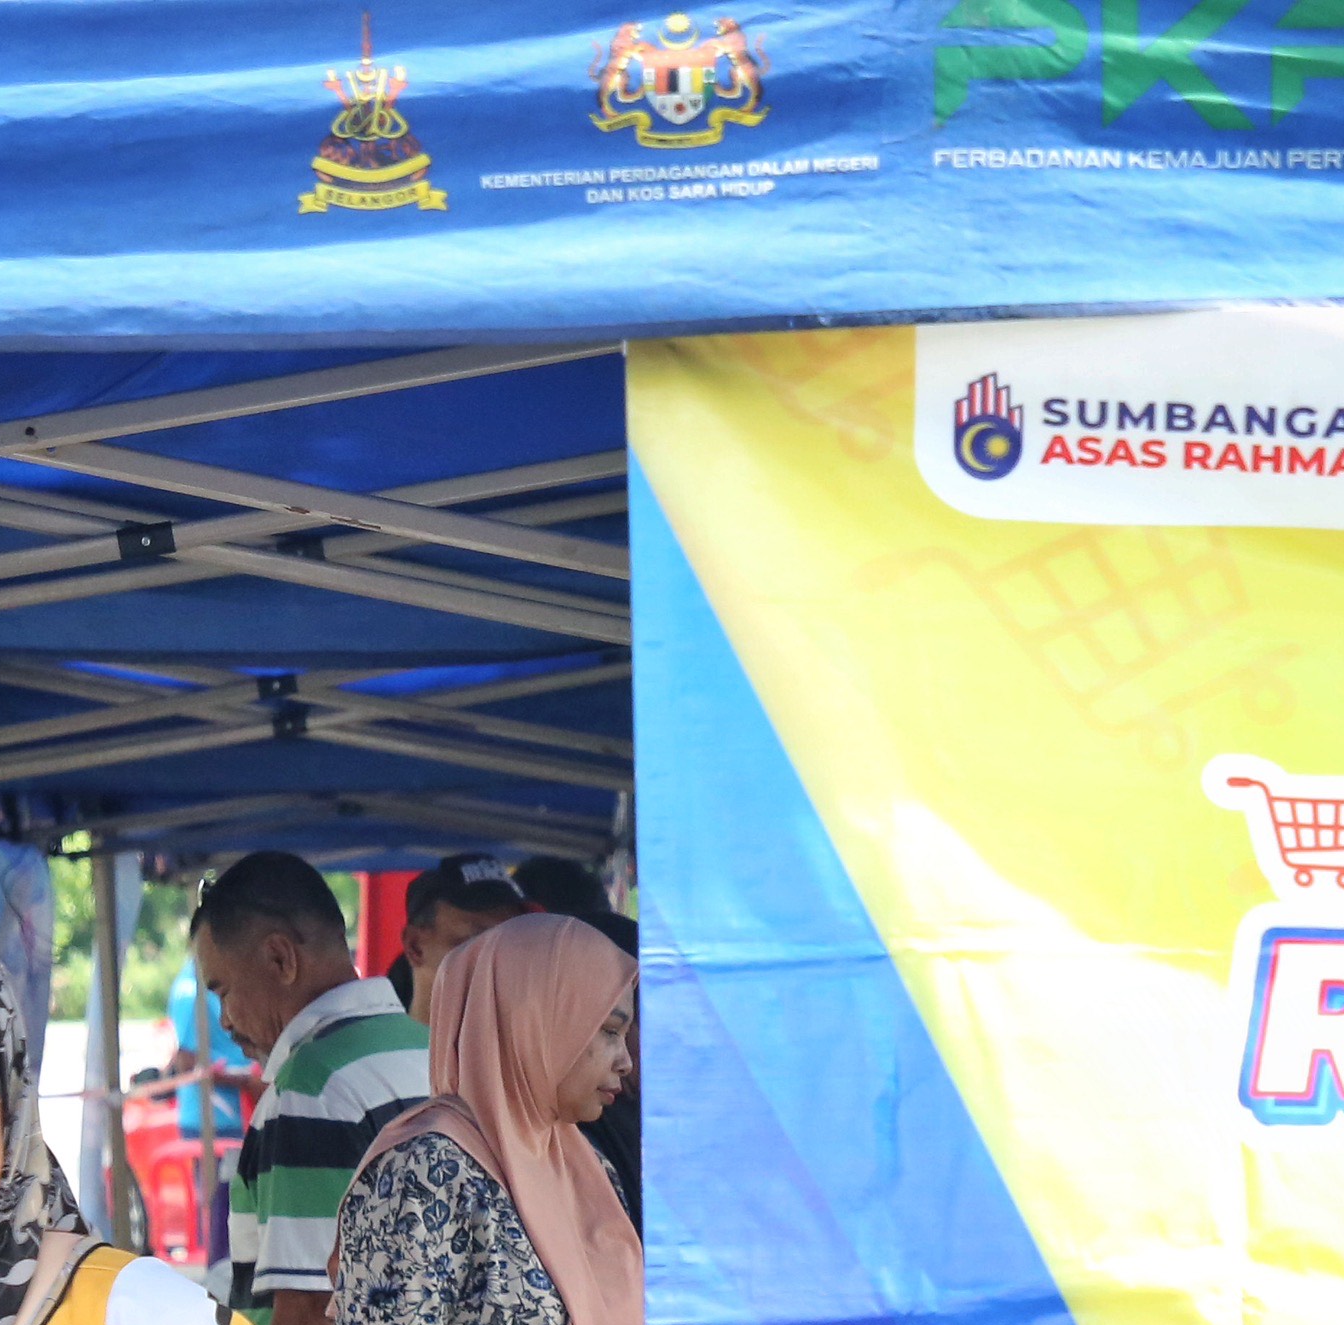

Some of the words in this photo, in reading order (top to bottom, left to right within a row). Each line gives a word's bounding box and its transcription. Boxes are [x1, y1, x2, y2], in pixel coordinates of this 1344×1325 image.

[480, 170, 605, 189] KEMENTERIAN
[610, 164, 743, 183] PERDAGANGAN
[747, 160, 810, 178] DALAM
[813, 156, 878, 173] NEGERI
[933, 147, 1121, 170] PERBADANAN
[1128, 149, 1281, 170] KEMAJUAN
[587, 188, 624, 204] DAN
[628, 185, 664, 202] KOS
[669, 183, 716, 200] SARA
[720, 180, 775, 197] HIDUP
[1040, 434, 1167, 468] ASAS
